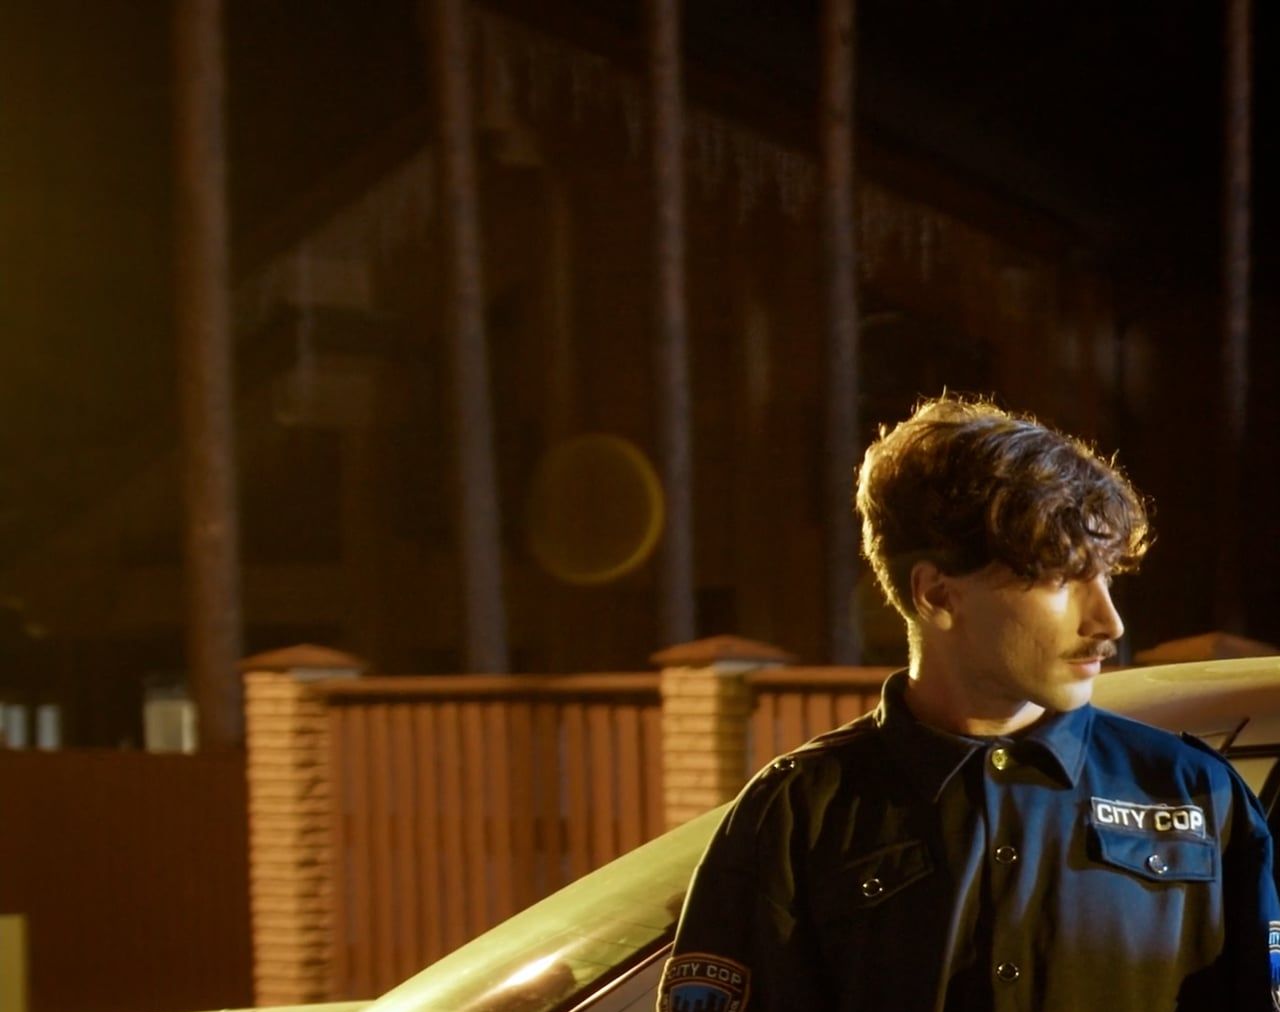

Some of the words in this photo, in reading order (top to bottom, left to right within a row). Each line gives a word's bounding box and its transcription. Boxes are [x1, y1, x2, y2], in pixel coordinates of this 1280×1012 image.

[1097, 804, 1146, 829] CITY
[1154, 810, 1204, 832] COP
[706, 964, 743, 985] COP
